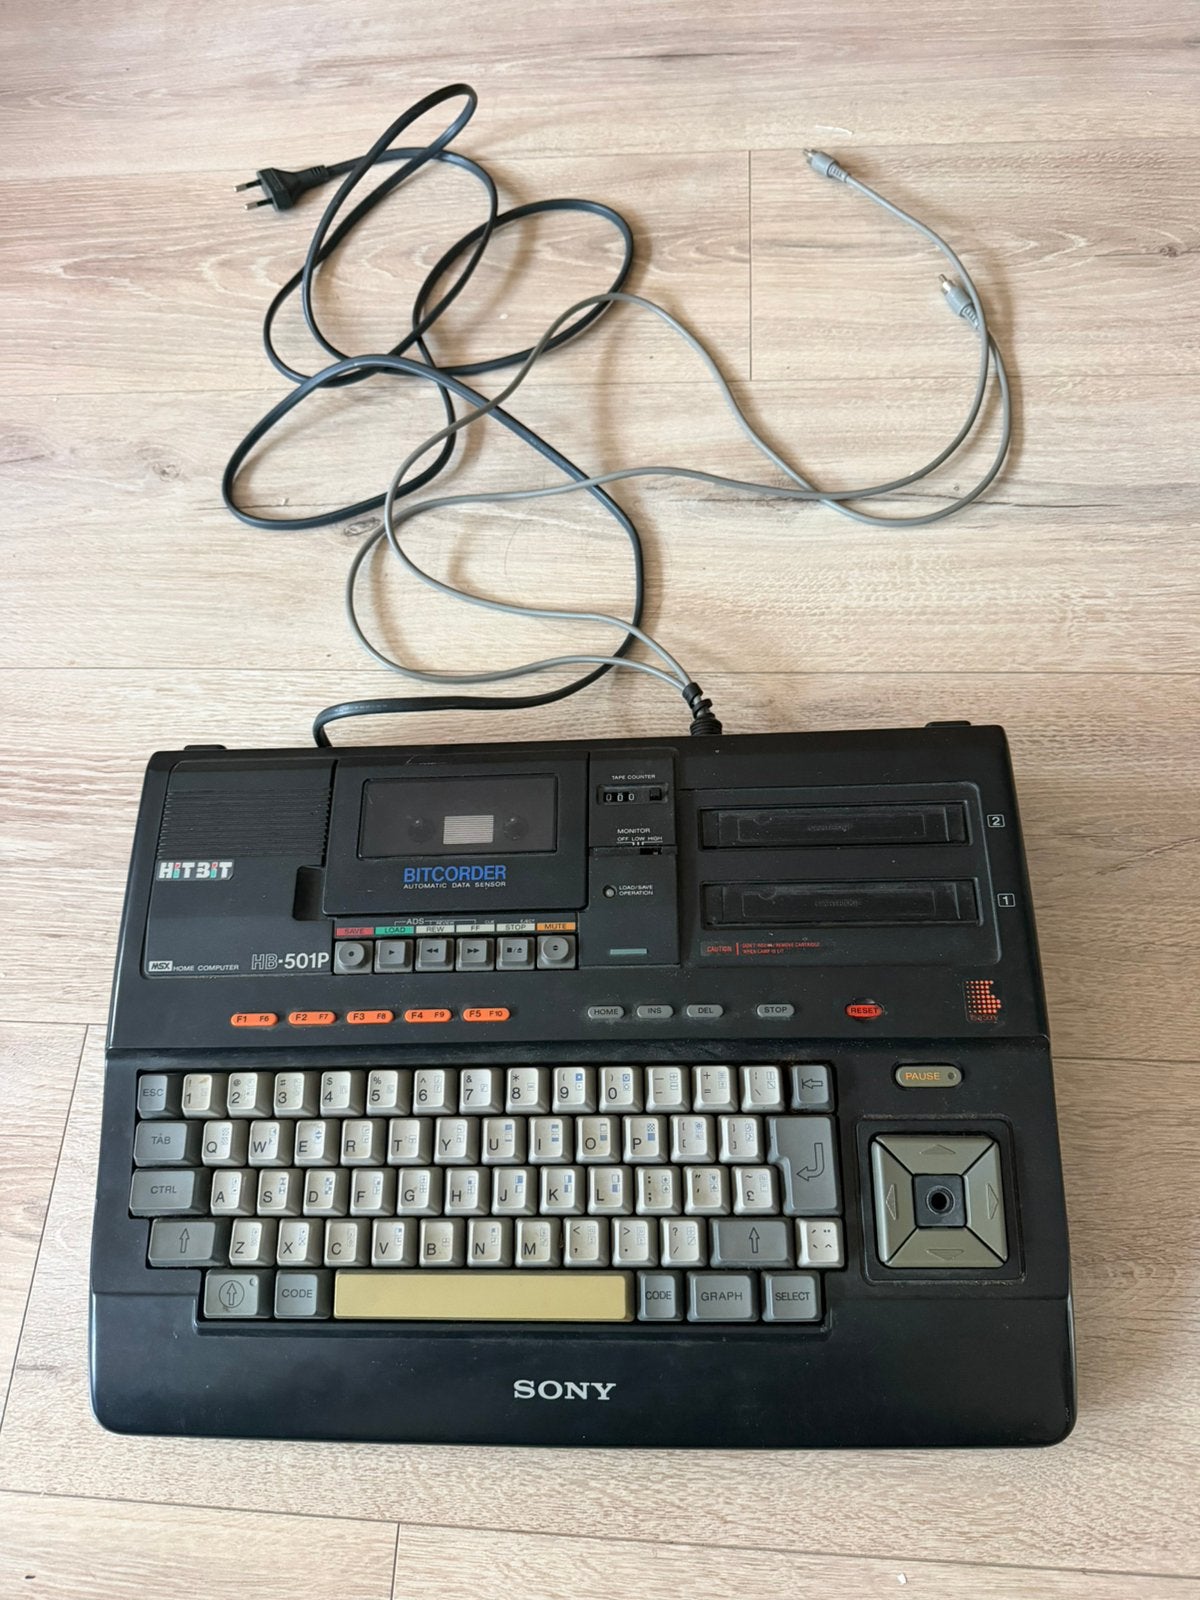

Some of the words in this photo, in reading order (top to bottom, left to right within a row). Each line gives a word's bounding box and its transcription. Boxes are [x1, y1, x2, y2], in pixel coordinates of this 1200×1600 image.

[403, 865, 506, 883] BITCORDER
[406, 917, 425, 925] ADS
[707, 946, 732, 954] CAUTION
[251, 952, 329, 970] HB-501P
[295, 1013, 308, 1021] F2
[353, 1013, 365, 1021] F3
[411, 1011, 423, 1019] F4
[469, 1010, 481, 1018] F5
[905, 1072, 940, 1081] PAUSE
[143, 1088, 164, 1097] ESC
[186, 1093, 192, 1104] 1
[232, 1092, 240, 1104] 2
[278, 1092, 287, 1104] 3
[324, 1091, 333, 1102] 4
[371, 1090, 380, 1102] 5
[419, 1089, 428, 1102] 6
[465, 1089, 474, 1101] 7
[512, 1087, 521, 1100] 8
[560, 1086, 569, 1099] 9
[608, 1087, 617, 1100] 0
[152, 1135, 171, 1145] TAB
[346, 1140, 356, 1152] R
[394, 1140, 402, 1151] T
[442, 1139, 451, 1151] Y
[489, 1139, 499, 1151] U
[585, 1137, 596, 1150] O
[632, 1138, 642, 1150] P
[206, 1141, 218, 1154] Q
[253, 1141, 267, 1153] W
[299, 1140, 308, 1153] E
[150, 1186, 177, 1194] CTRL
[404, 1189, 415, 1202] G
[452, 1190, 461, 1202] H
[500, 1189, 507, 1202] J
[549, 1189, 559, 1201] K
[596, 1189, 604, 1201] L
[215, 1191, 225, 1202] A
[263, 1191, 273, 1203] S
[308, 1191, 319, 1202] D
[356, 1191, 366, 1203] F
[235, 1242, 245, 1254] Z
[283, 1242, 293, 1254] X
[331, 1242, 341, 1255] C
[379, 1242, 389, 1254] V
[427, 1243, 436, 1255] B
[475, 1243, 485, 1255] N
[524, 1243, 536, 1255] M
[281, 1289, 312, 1298] CODE
[645, 1291, 672, 1300] CODE
[701, 1292, 743, 1301] GRAPH
[775, 1292, 810, 1301] SELECT
[513, 1379, 617, 1400] SONY
